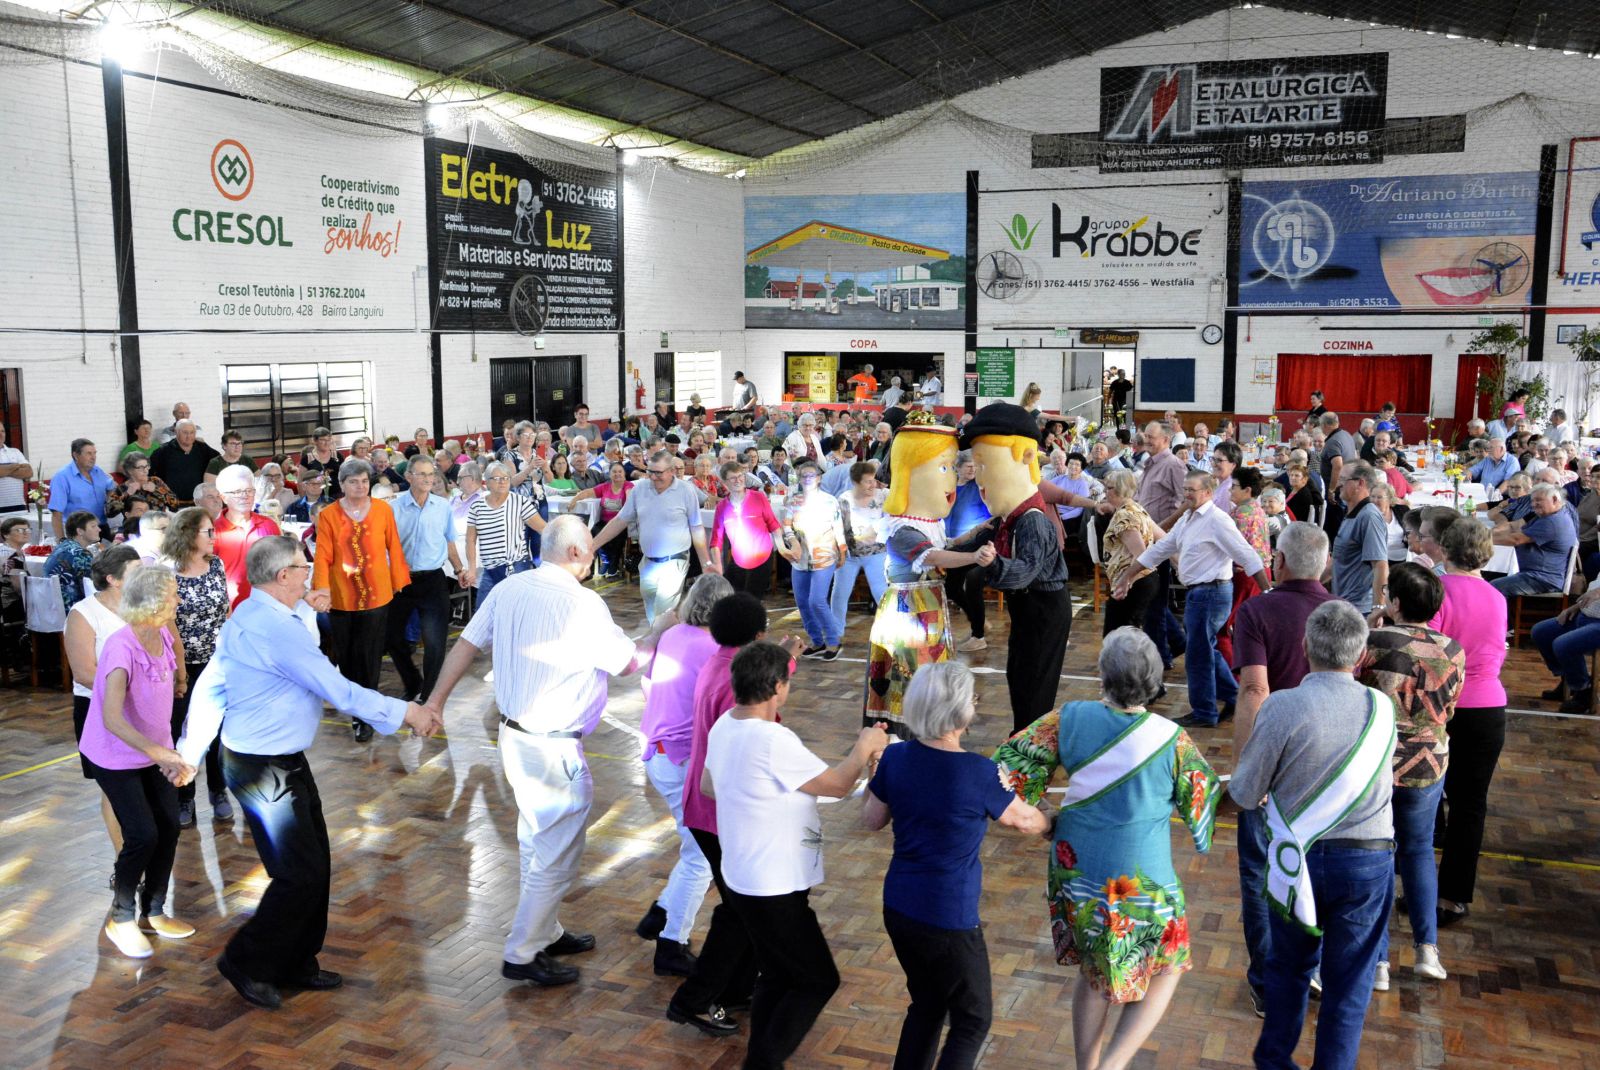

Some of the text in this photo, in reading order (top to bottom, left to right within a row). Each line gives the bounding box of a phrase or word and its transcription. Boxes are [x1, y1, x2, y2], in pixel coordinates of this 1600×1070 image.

[1244, 130, 1369, 148] (51) 9757-6156
[1119, 148, 1140, 156] Paulo
[1142, 147, 1176, 156] Luciano
[1180, 145, 1214, 154] Wunder
[1283, 152, 1348, 162] WESTFÁLIA
[1121, 160, 1164, 168] CRISTIANO
[321, 174, 400, 197] Cooperativismo
[541, 180, 555, 197] (51)
[1361, 180, 1456, 202] Adriano
[1462, 177, 1532, 198] Barth
[322, 195, 395, 214] de Crédito que
[322, 214, 358, 229] realiza
[445, 212, 464, 222] e-mail:
[1397, 210, 1516, 220] CIRURGIÃO DENTISTA
[172, 208, 293, 248] CRESOL
[546, 210, 592, 250] Luz
[1052, 202, 1202, 258] Krabbe
[1090, 220, 1130, 233] grupo
[324, 213, 402, 258] sonhos!
[872, 238, 926, 256] Posto da Cidade
[459, 242, 612, 273] Materiais e Serviços Elétricos
[588, 276, 606, 285] ELÉTRICO
[1025, 280, 1041, 289] (51)
[1094, 279, 1140, 288] 3762-4556
[1150, 277, 1195, 287] Westfália
[218, 284, 250, 296] Cresol
[252, 284, 294, 298] Teutônia
[595, 286, 613, 295] ELÉTRICA
[448, 296, 460, 308] 828
[200, 303, 384, 319] Rua 03 de Outubro, 428 Bairro Languiru
[561, 318, 564, 326] e
[565, 315, 595, 328] Instalação
[596, 315, 603, 327] de
[850, 339, 878, 349] COPA
[1323, 340, 1374, 350] COZINHA
